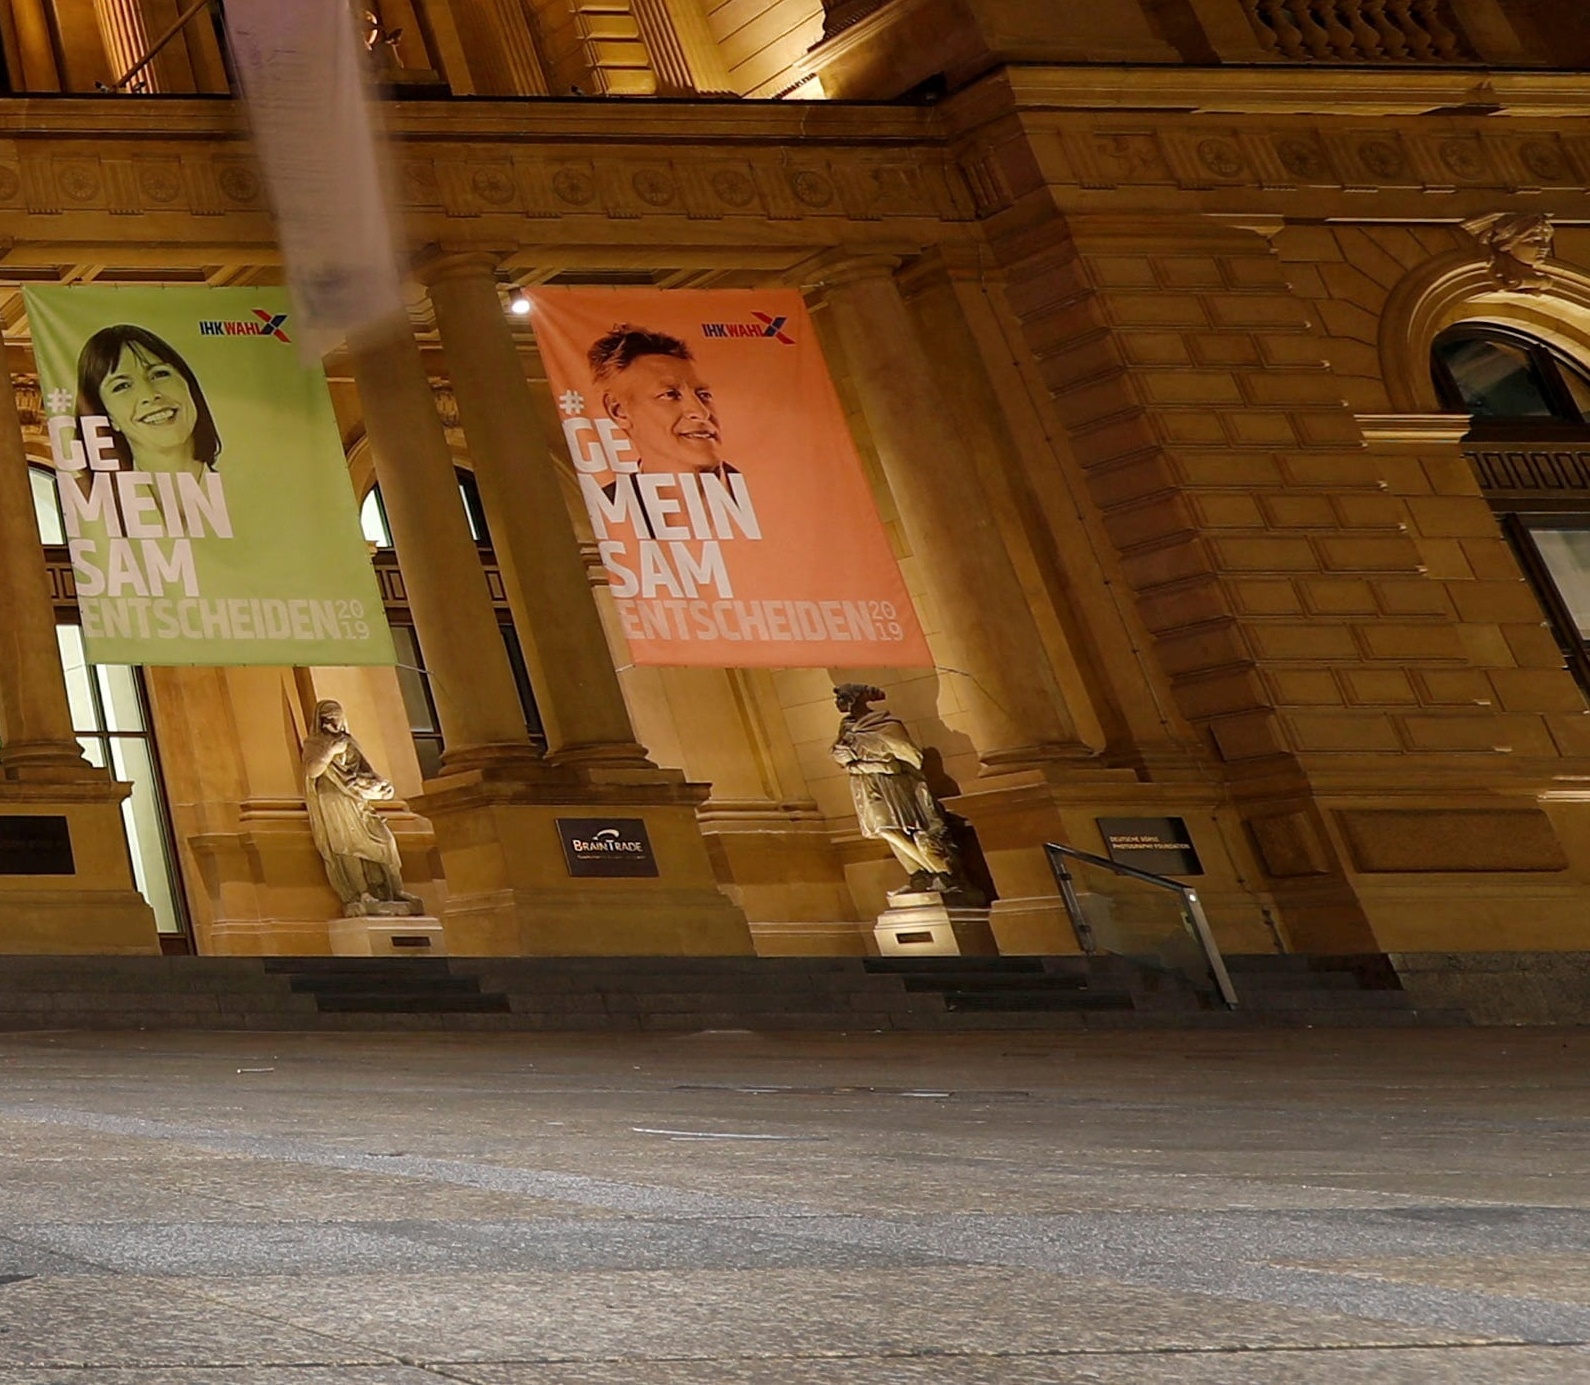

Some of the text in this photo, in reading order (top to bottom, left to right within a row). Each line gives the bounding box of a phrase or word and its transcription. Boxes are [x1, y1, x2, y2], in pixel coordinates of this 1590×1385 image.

[48, 415, 120, 471] GE
[562, 416, 640, 474] GE
[57, 471, 234, 539] MEIN
[577, 472, 762, 541] MEIN
[68, 538, 200, 597] SAM
[597, 540, 734, 599] SAM
[80, 598, 342, 640] ENTSCHEIDEN
[618, 599, 876, 641] ENTSCHEIDEN
